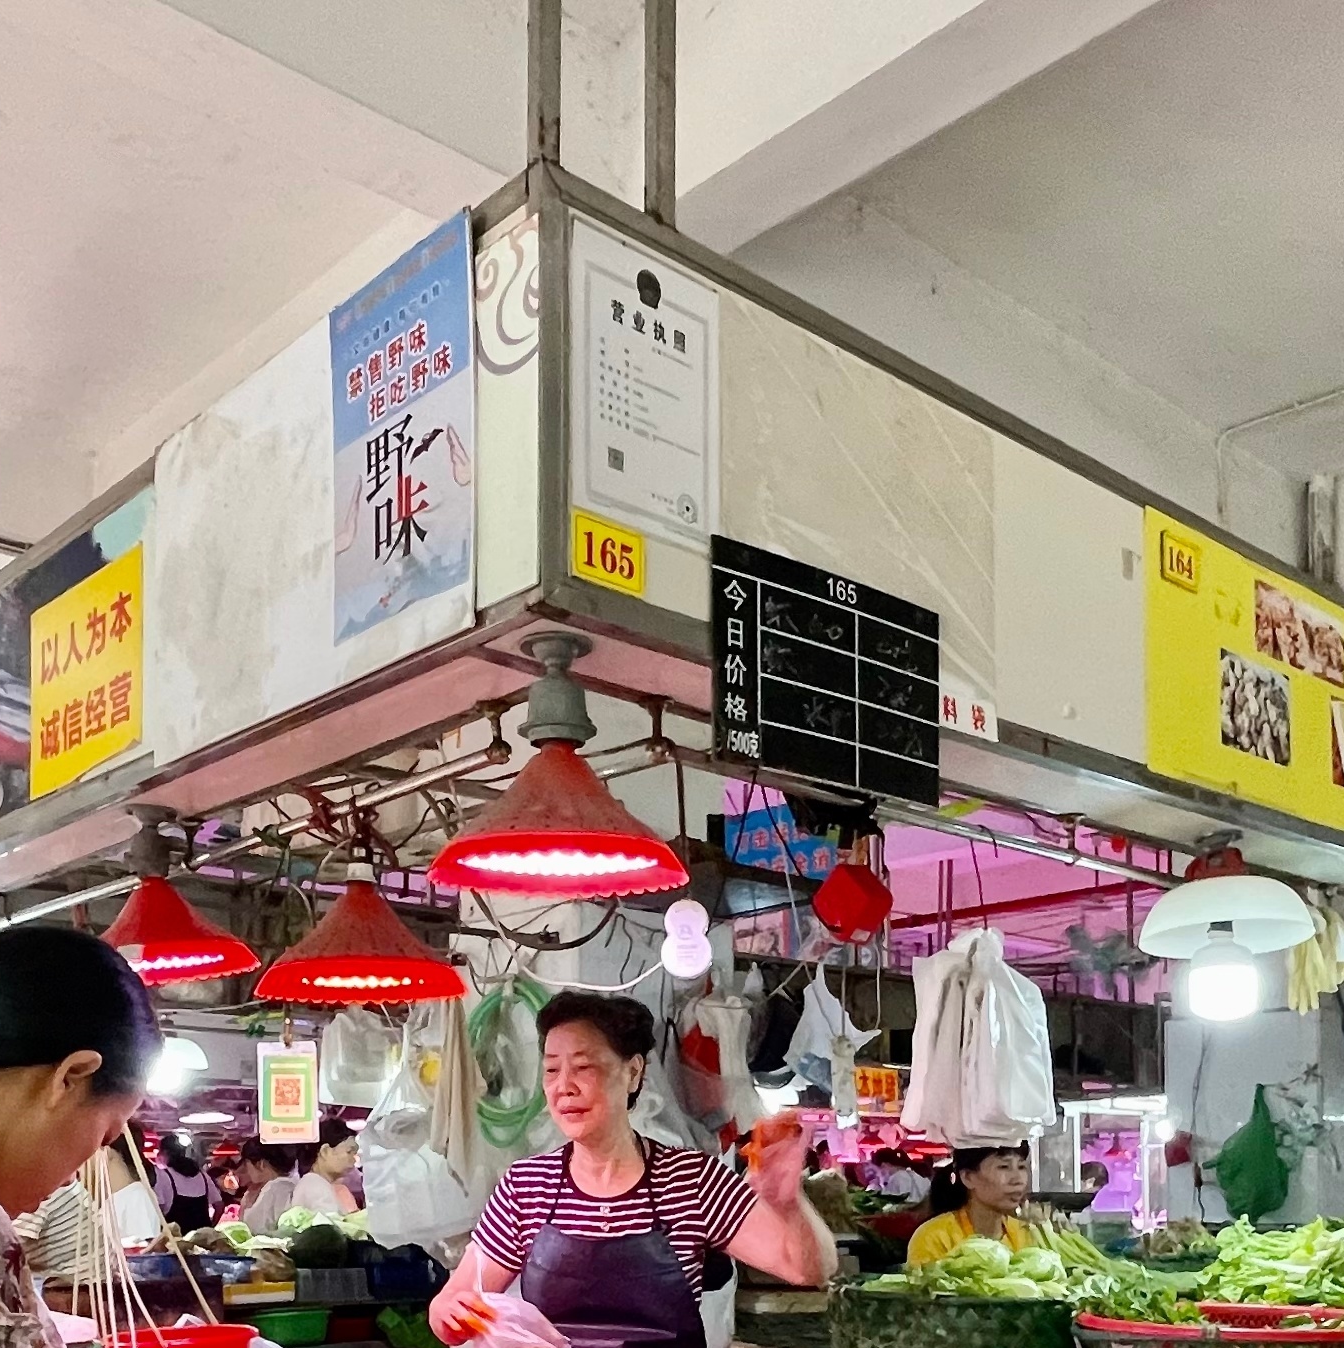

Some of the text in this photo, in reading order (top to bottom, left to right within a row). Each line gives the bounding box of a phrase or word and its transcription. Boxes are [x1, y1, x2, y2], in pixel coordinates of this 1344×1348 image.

[347, 322, 426, 399] 禁售野味
[368, 344, 451, 421] 拒吃野味
[366, 414, 430, 565] 野味
[583, 531, 635, 580] 165
[826, 577, 857, 604] 165
[1168, 545, 1193, 580] 164
[41, 592, 133, 685] 以人为本
[723, 579, 748, 722] 今日价格
[40, 671, 133, 760] 诚信经营
